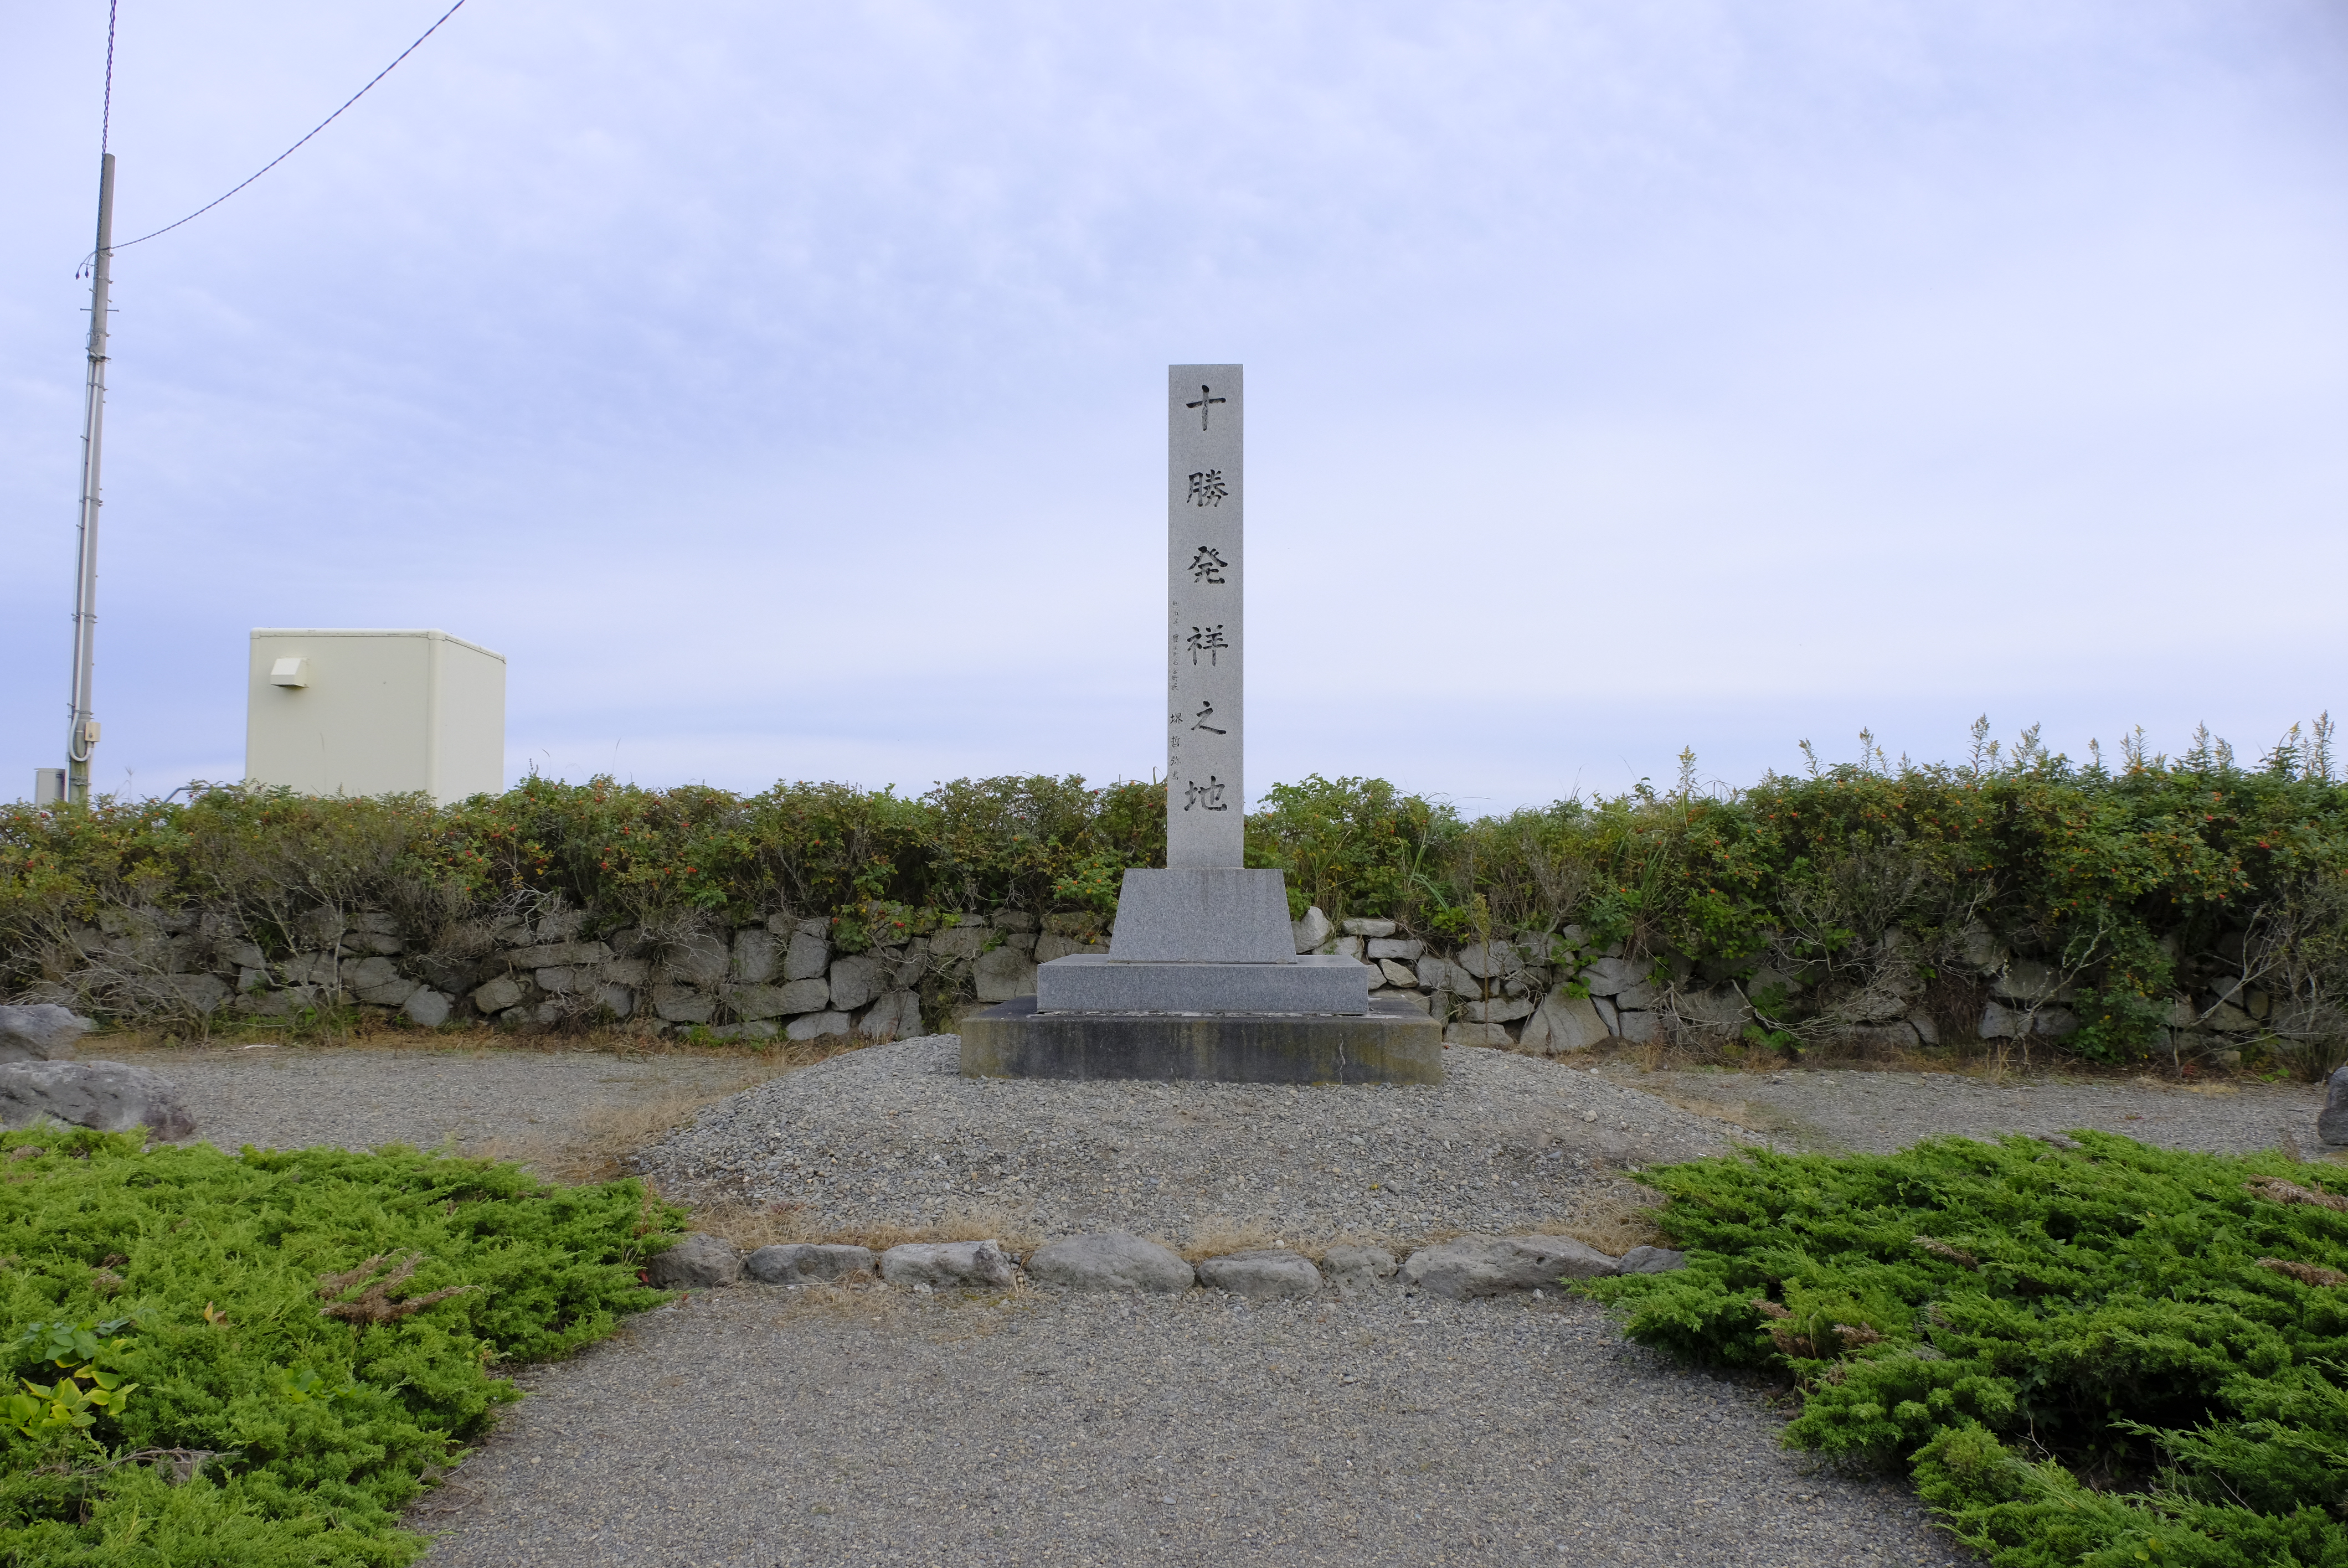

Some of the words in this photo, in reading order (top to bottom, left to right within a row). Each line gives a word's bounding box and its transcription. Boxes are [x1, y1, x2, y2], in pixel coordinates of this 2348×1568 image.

[1185, 384, 1229, 812] 十勝発祥之地
